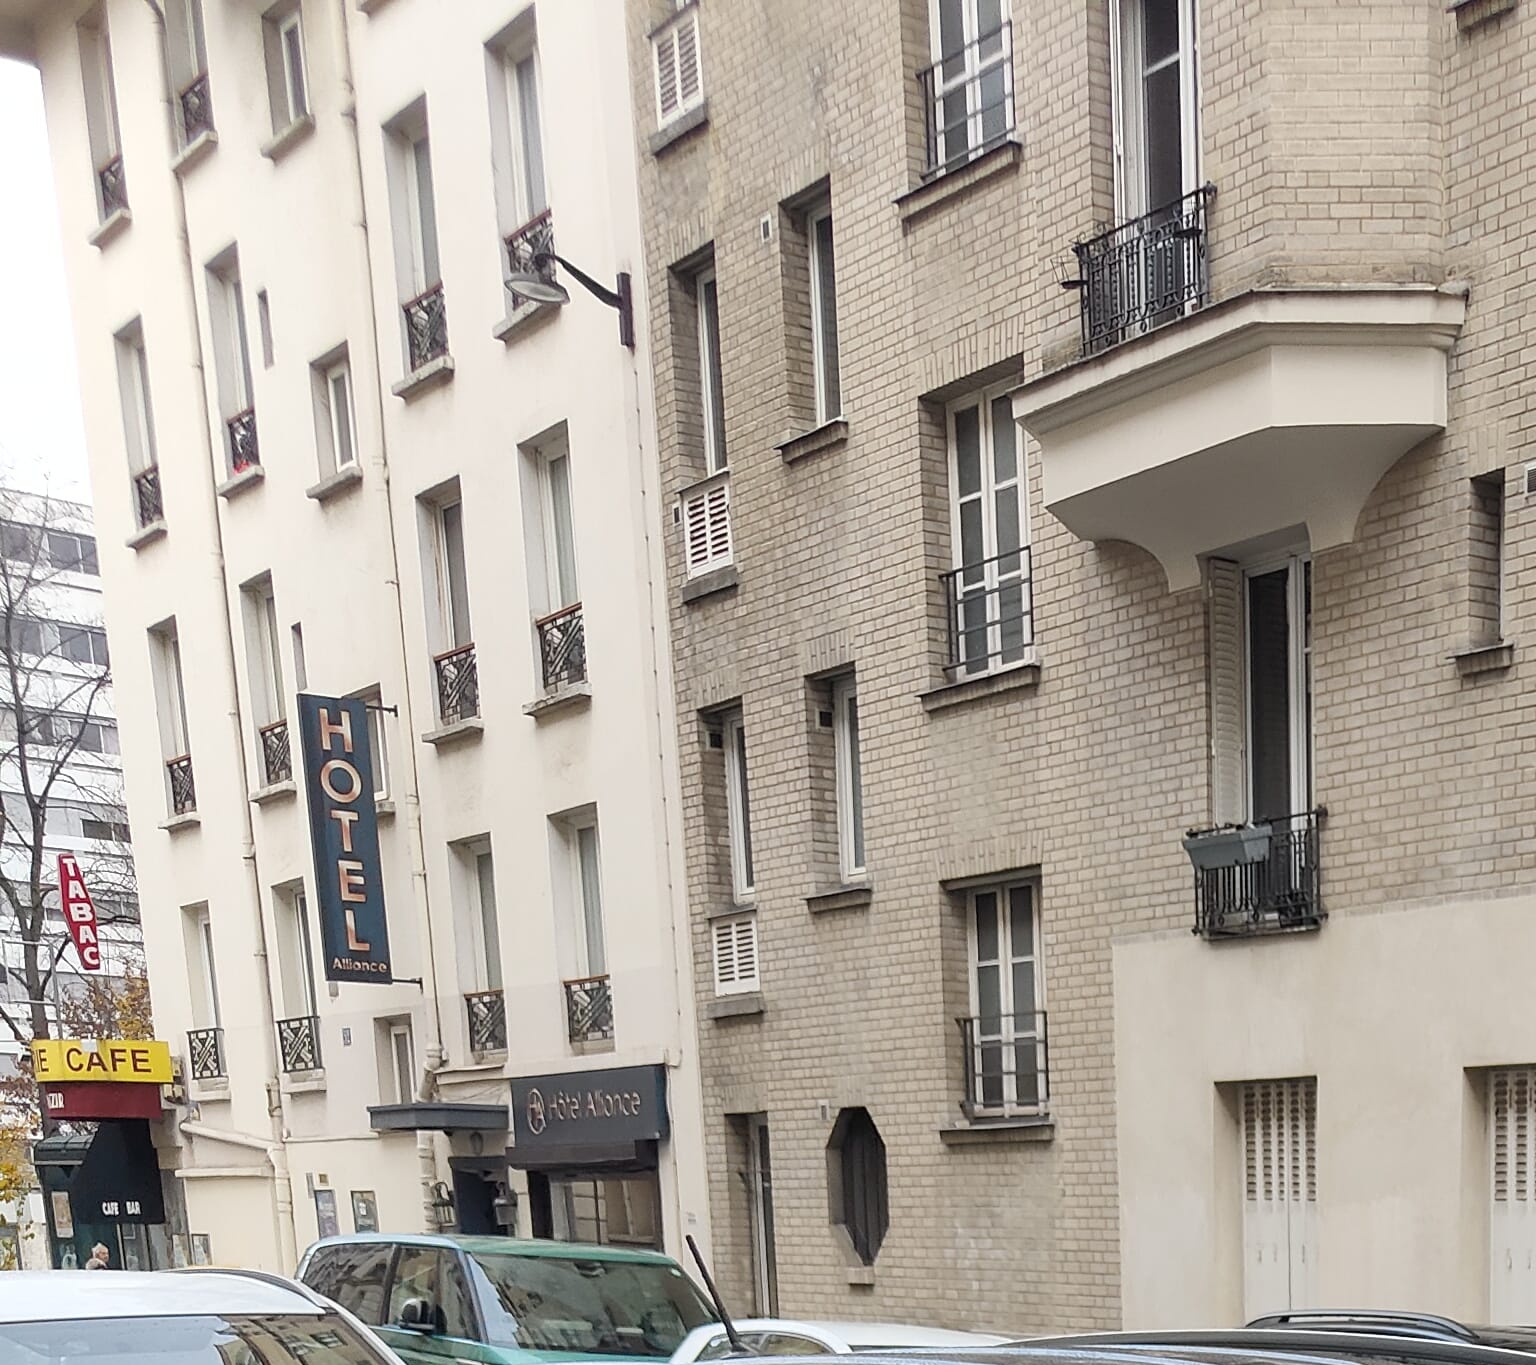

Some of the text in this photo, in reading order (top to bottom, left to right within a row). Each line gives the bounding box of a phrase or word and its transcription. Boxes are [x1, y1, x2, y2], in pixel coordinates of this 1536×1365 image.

[319, 708, 370, 951] HOTEL
[62, 857, 99, 966] TABAC
[332, 956, 388, 973] Alliance
[66, 1047, 152, 1073] CAFE
[548, 1088, 641, 1121] Hôtel Alliance
[102, 1200, 141, 1216] CAFE BAR
